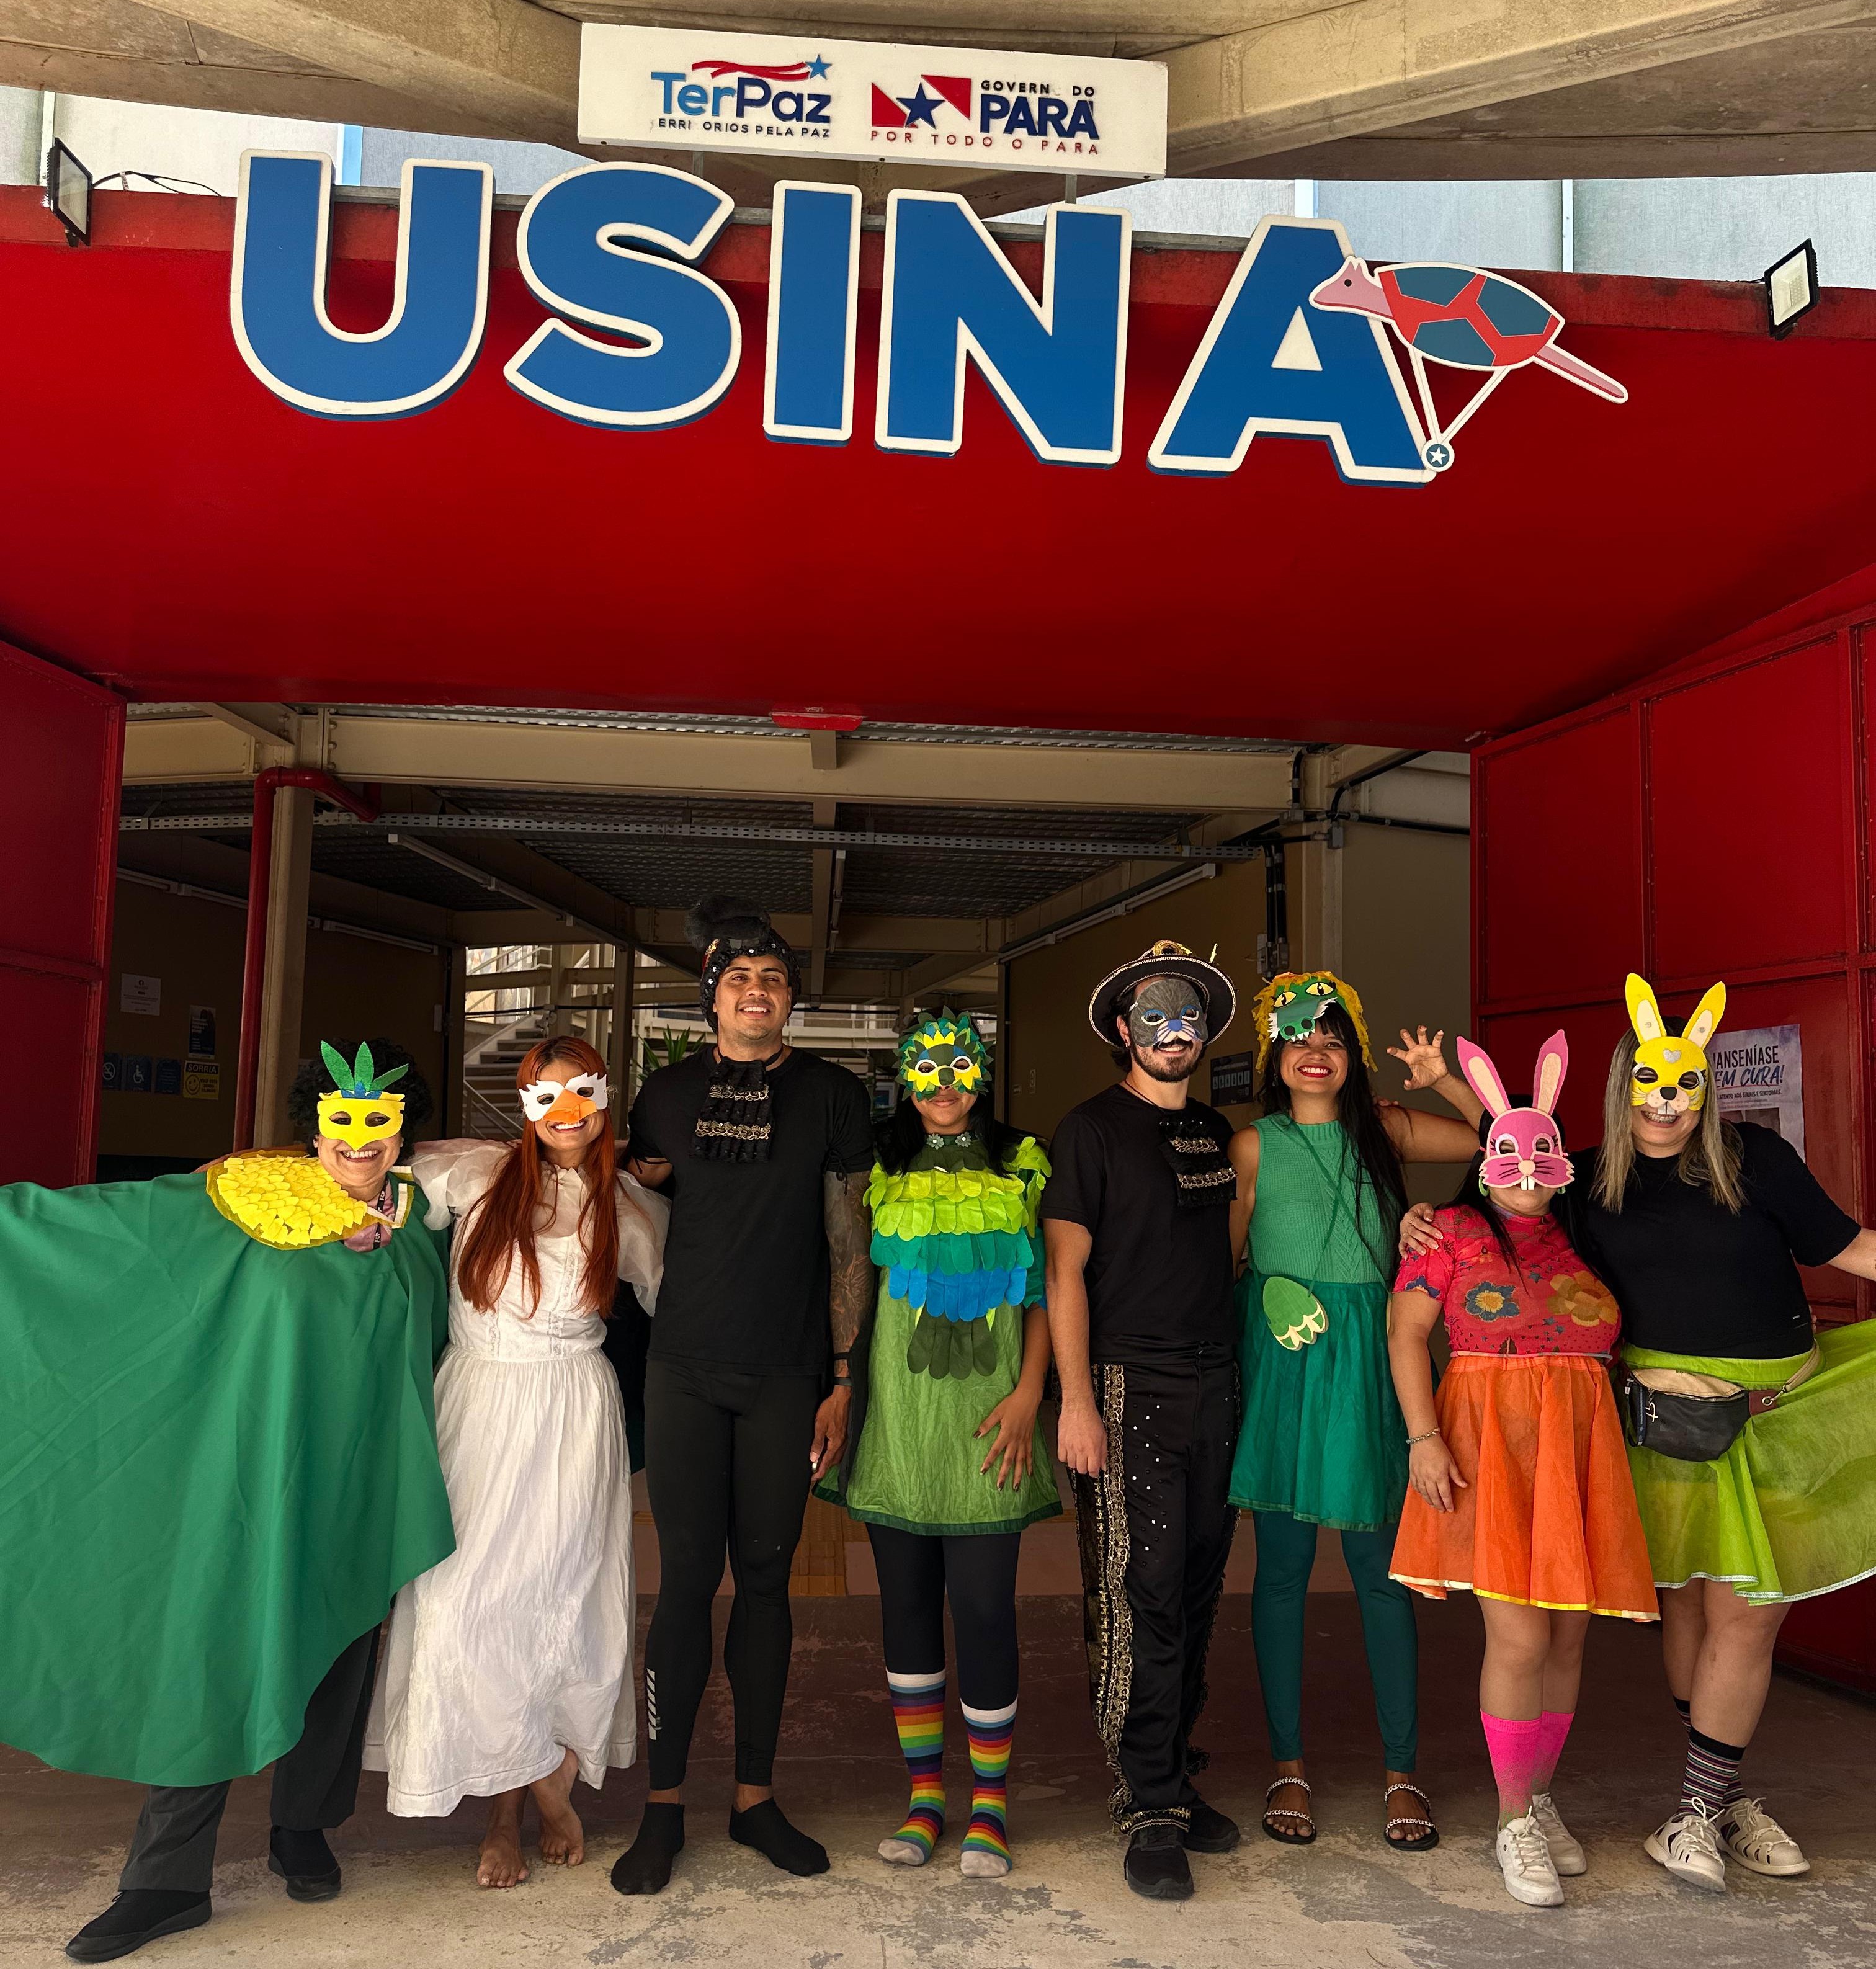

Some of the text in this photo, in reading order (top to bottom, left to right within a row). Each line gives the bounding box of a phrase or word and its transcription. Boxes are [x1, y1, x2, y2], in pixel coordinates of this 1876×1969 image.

[651, 72, 831, 124] TerPaz
[1072, 86, 1095, 97] DO
[755, 125, 794, 137] PELA
[801, 127, 830, 138] PAZ
[870, 130, 1099, 155] POR TODO O PARA
[228, 150, 1439, 484] USINA
[188, 1063, 217, 1074] SORRIA
[1740, 1065, 1785, 1087] CURA!
